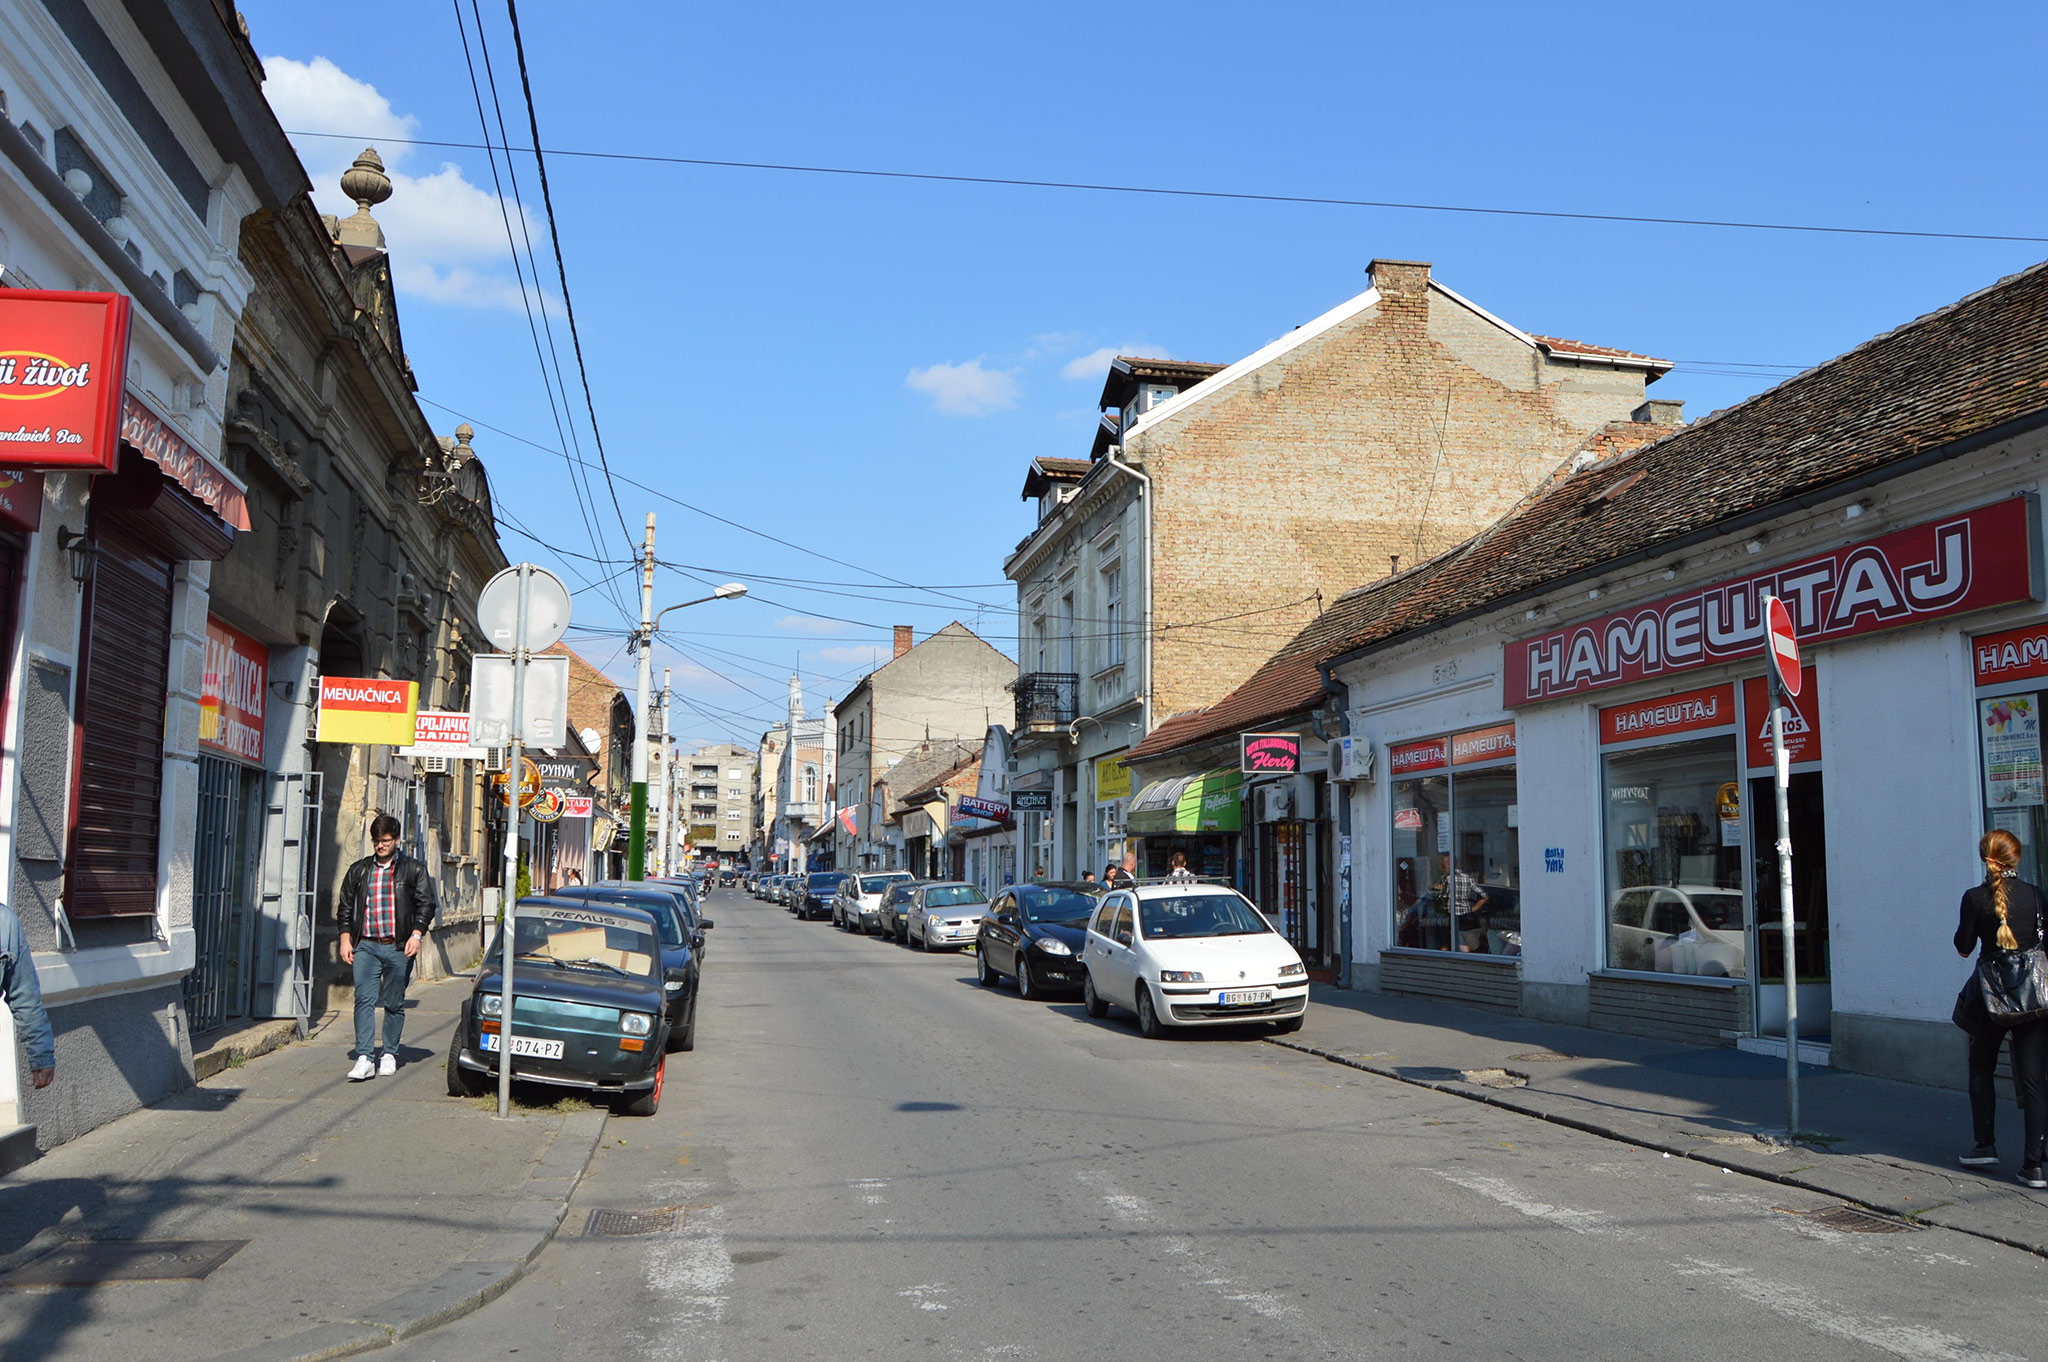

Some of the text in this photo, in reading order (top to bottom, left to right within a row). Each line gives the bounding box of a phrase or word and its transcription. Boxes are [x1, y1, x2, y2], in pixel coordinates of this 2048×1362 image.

[20, 357, 91, 388] život
[55, 428, 84, 445] Bar
[1526, 517, 1974, 701] НАМЕШТАЈ
[322, 687, 402, 704] MENJAČNICA
[415, 716, 470, 732] КРОЈАЧК
[1615, 696, 1718, 735] НАМЕШТАЈ
[1765, 718, 1802, 736] ATOS
[226, 718, 261, 759] OFFICE
[1391, 744, 1448, 767] НАМЕШТАЈ
[499, 783, 535, 794] Kzel
[962, 796, 1008, 814] BATTERY
[551, 911, 618, 926] REMUS
